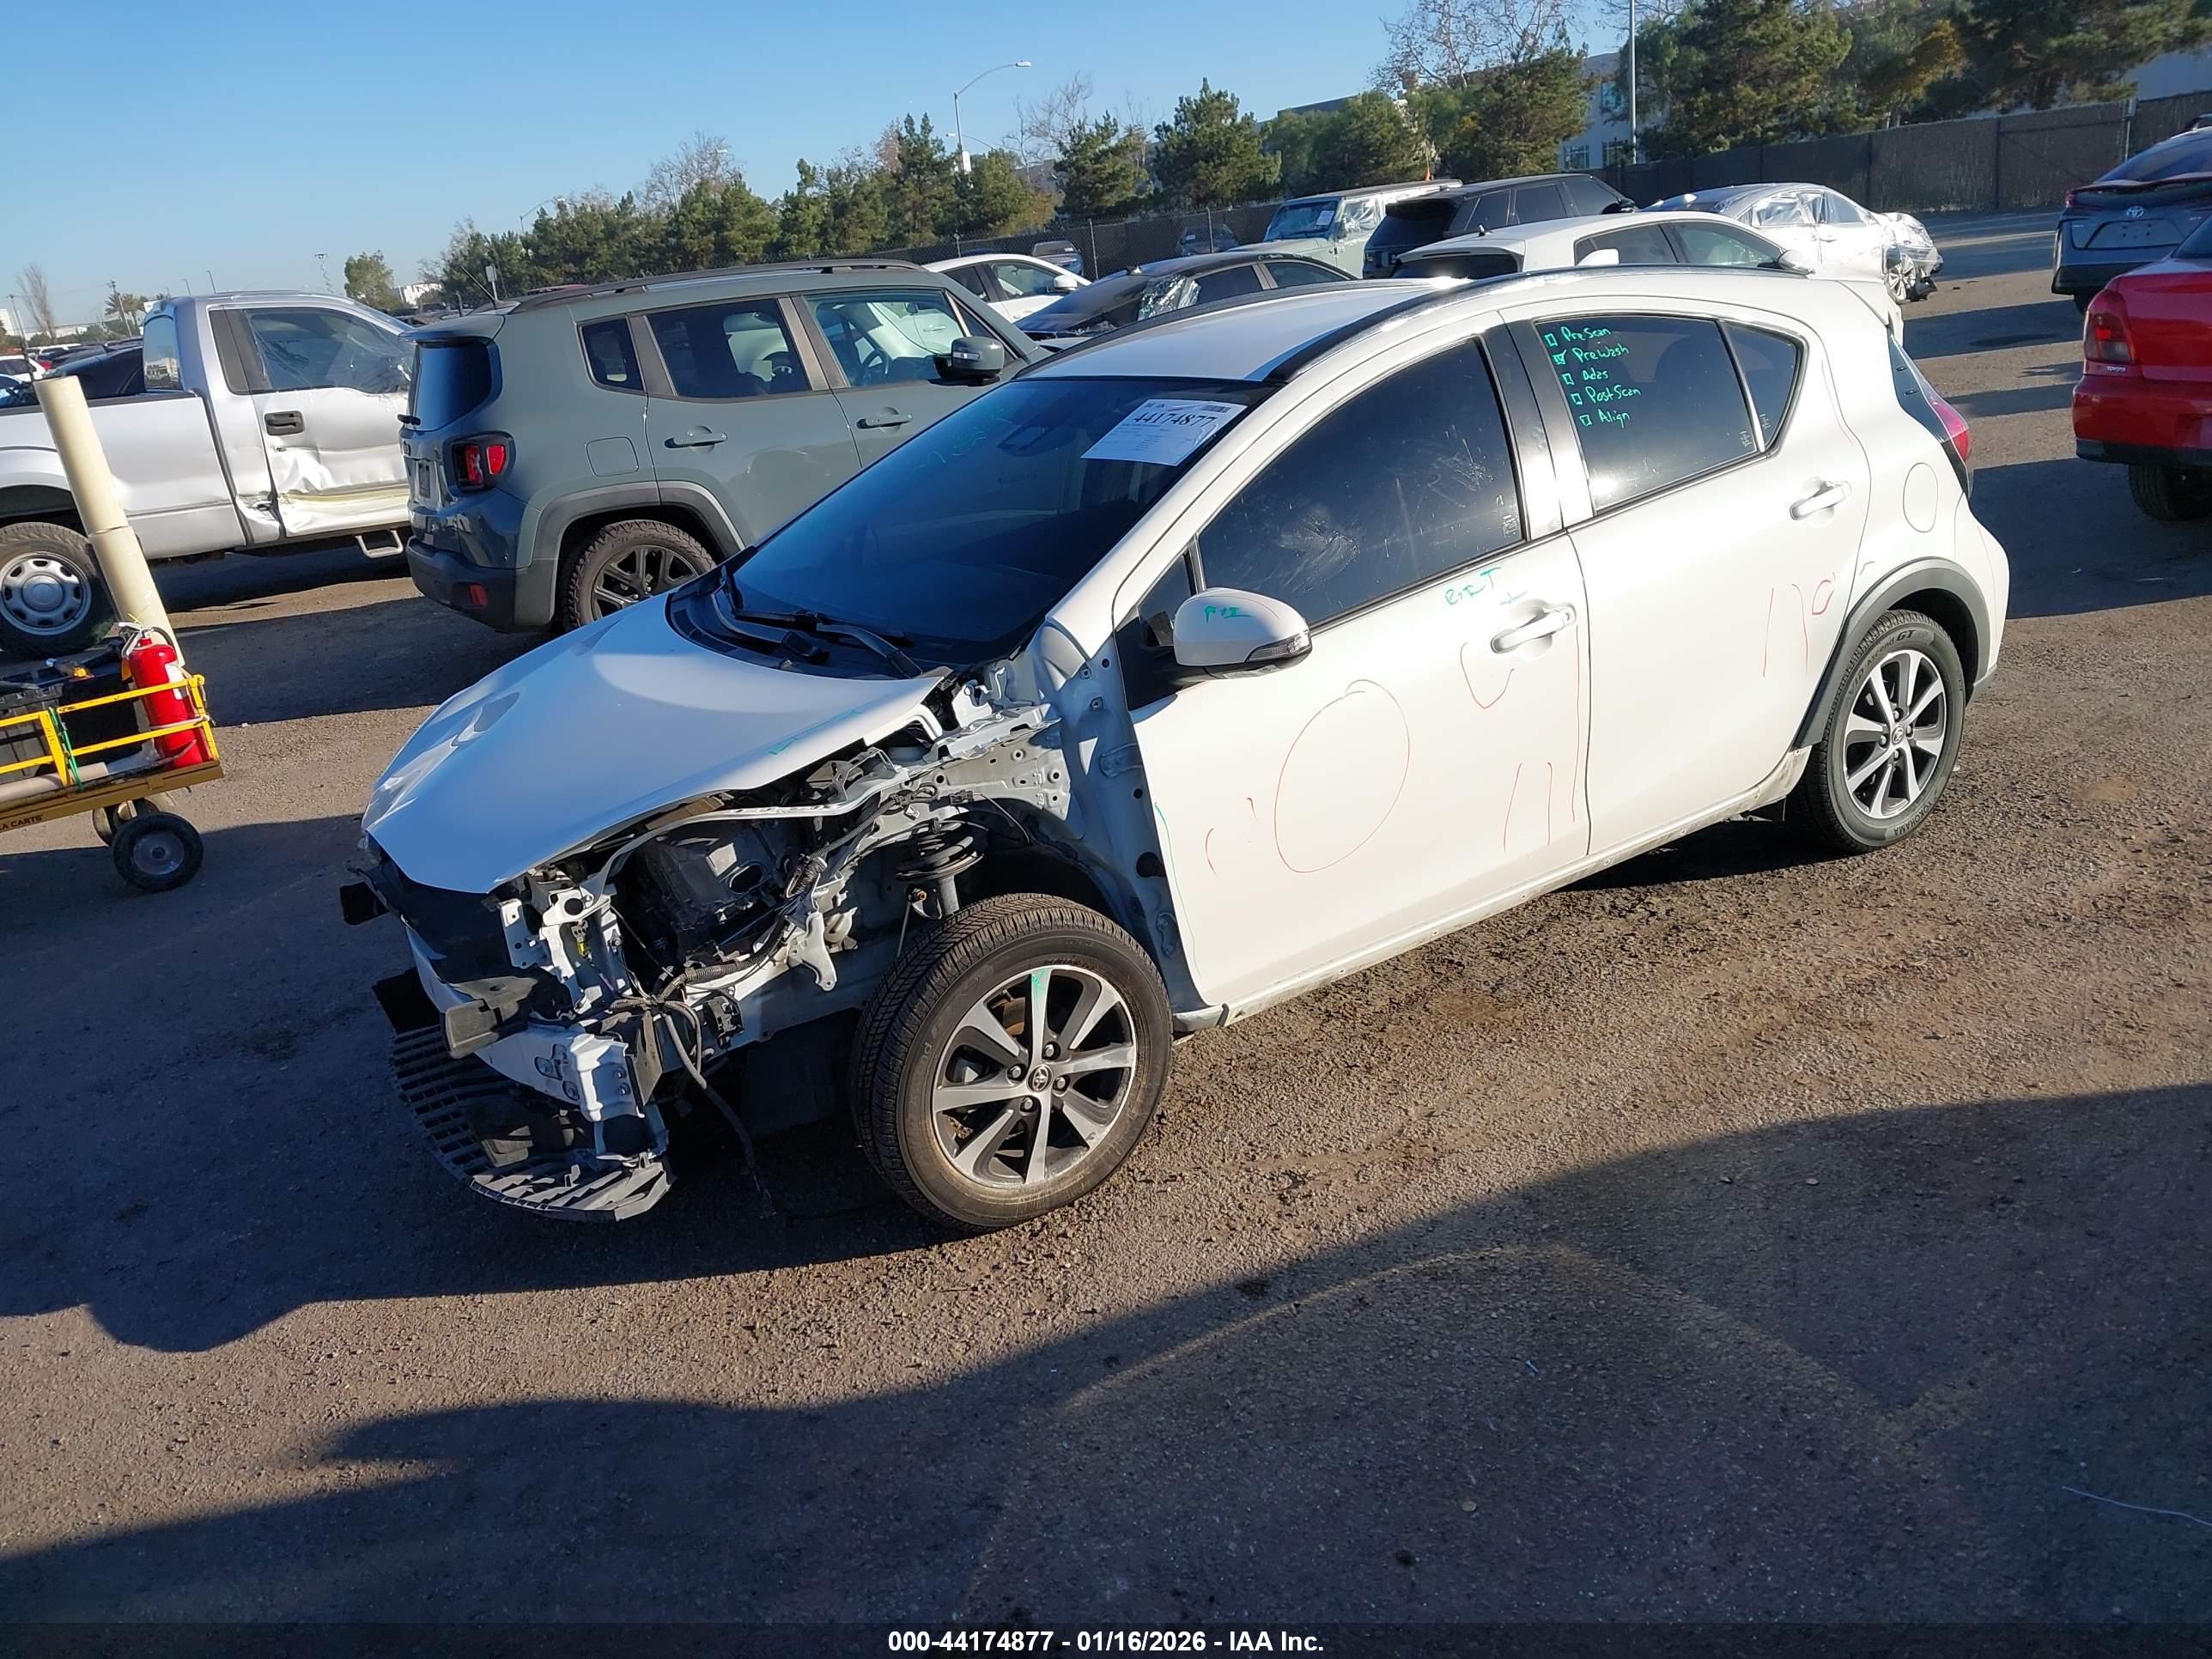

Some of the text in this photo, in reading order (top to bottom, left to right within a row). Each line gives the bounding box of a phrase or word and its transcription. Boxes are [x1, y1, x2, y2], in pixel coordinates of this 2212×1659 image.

[1133, 412, 1218, 427] 44174877
[1598, 409, 1630, 428] Align
[1896, 629, 1917, 641] GT
[1894, 800, 1933, 836] YOKOHAMA
